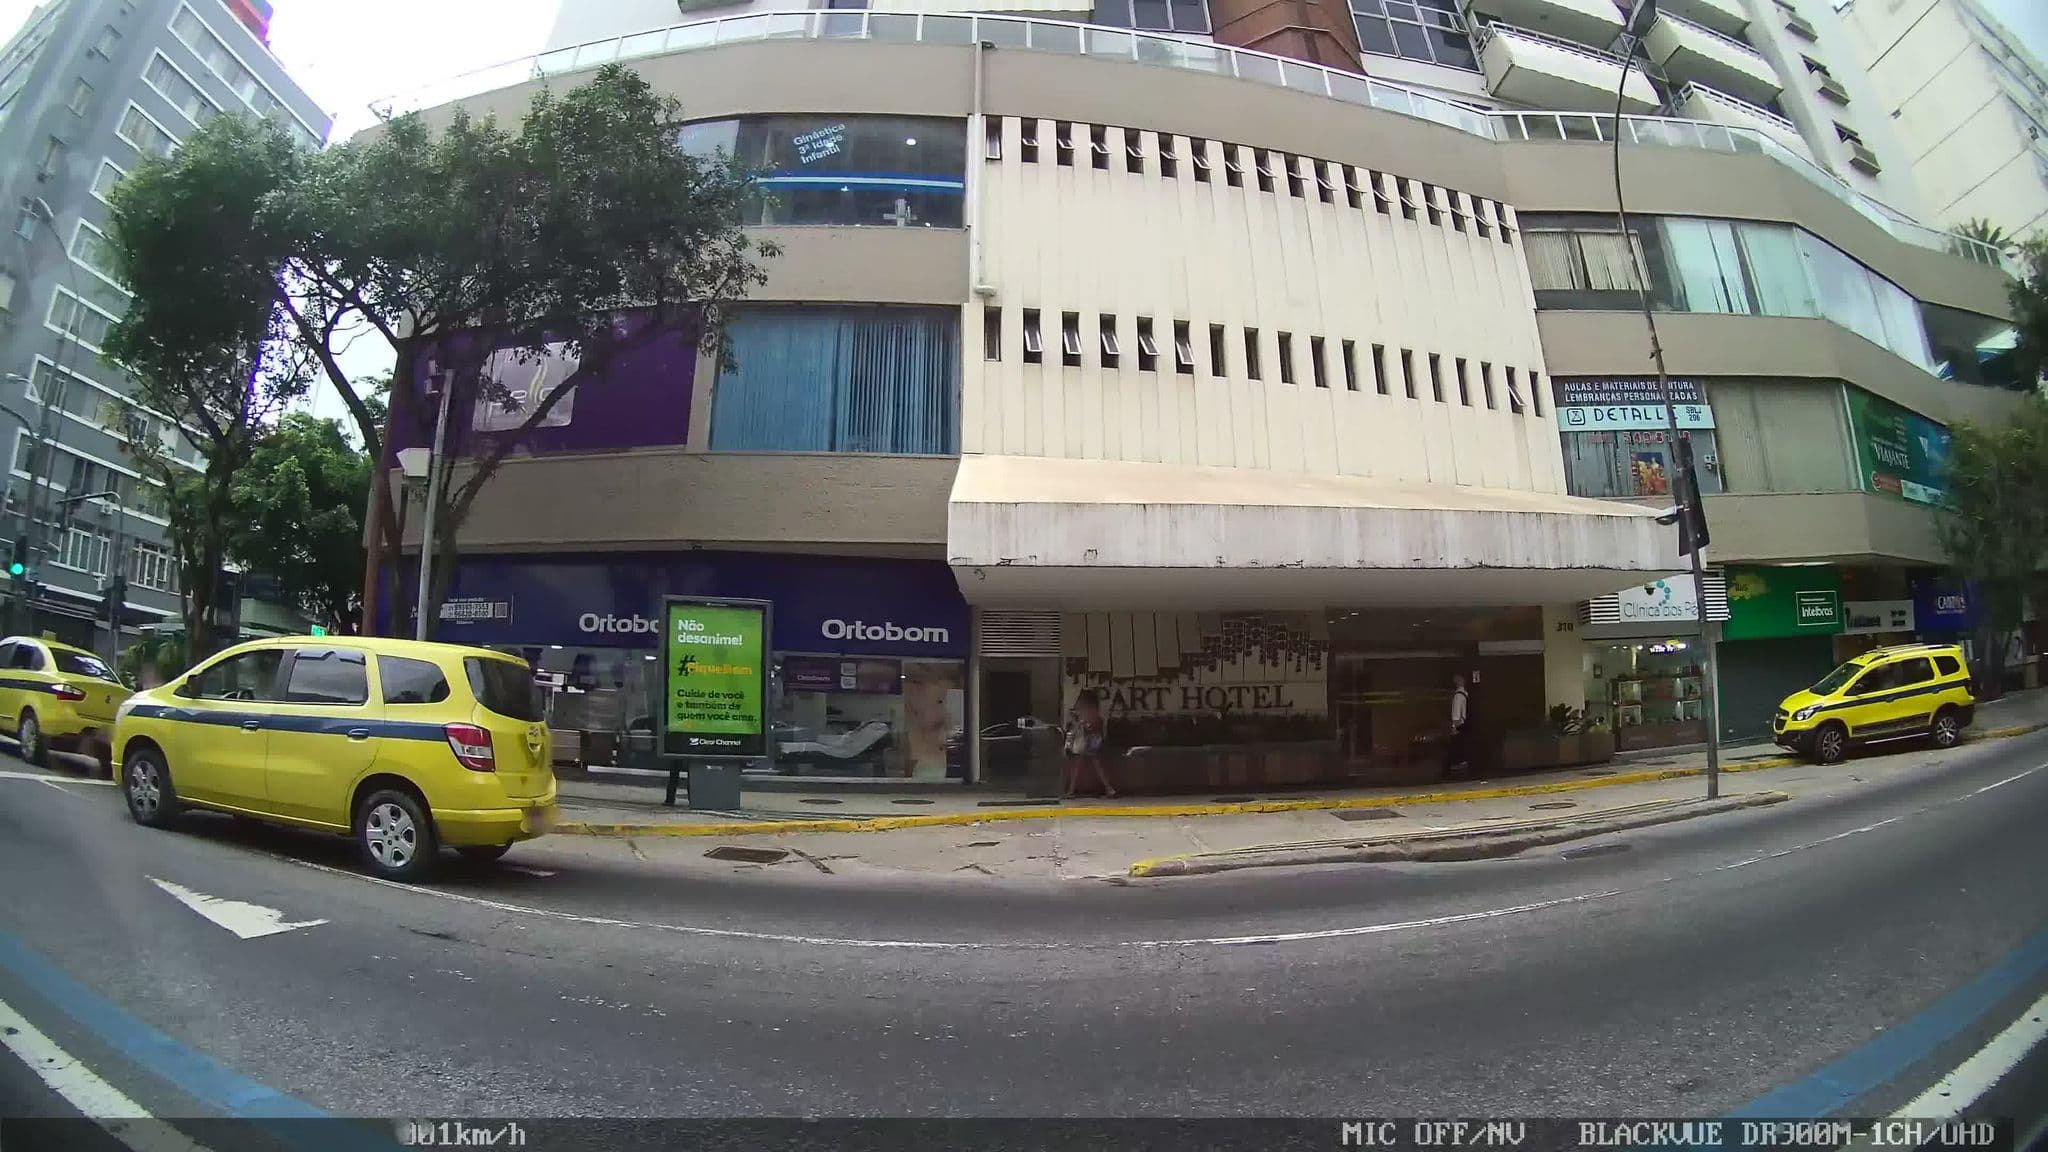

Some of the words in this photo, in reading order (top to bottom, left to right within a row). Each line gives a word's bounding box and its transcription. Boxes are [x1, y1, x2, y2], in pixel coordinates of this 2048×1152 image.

[800, 145, 840, 164] Infantil
[1565, 382, 1592, 391] AULAS
[1594, 382, 1600, 391] E
[1602, 381, 1645, 390] MATERIAIS
[1647, 381, 1658, 390] DE
[1801, 605, 1834, 617] Intelbras
[677, 619, 705, 632] Não
[821, 619, 949, 643] Ortobom
[677, 632, 743, 646] desanime!
[708, 689, 721, 699] de
[722, 690, 745, 699] você
[1181, 684, 1294, 710] HOTEL
[728, 702, 741, 710] de
[677, 712, 706, 721] quem
[708, 711, 731, 721] você
